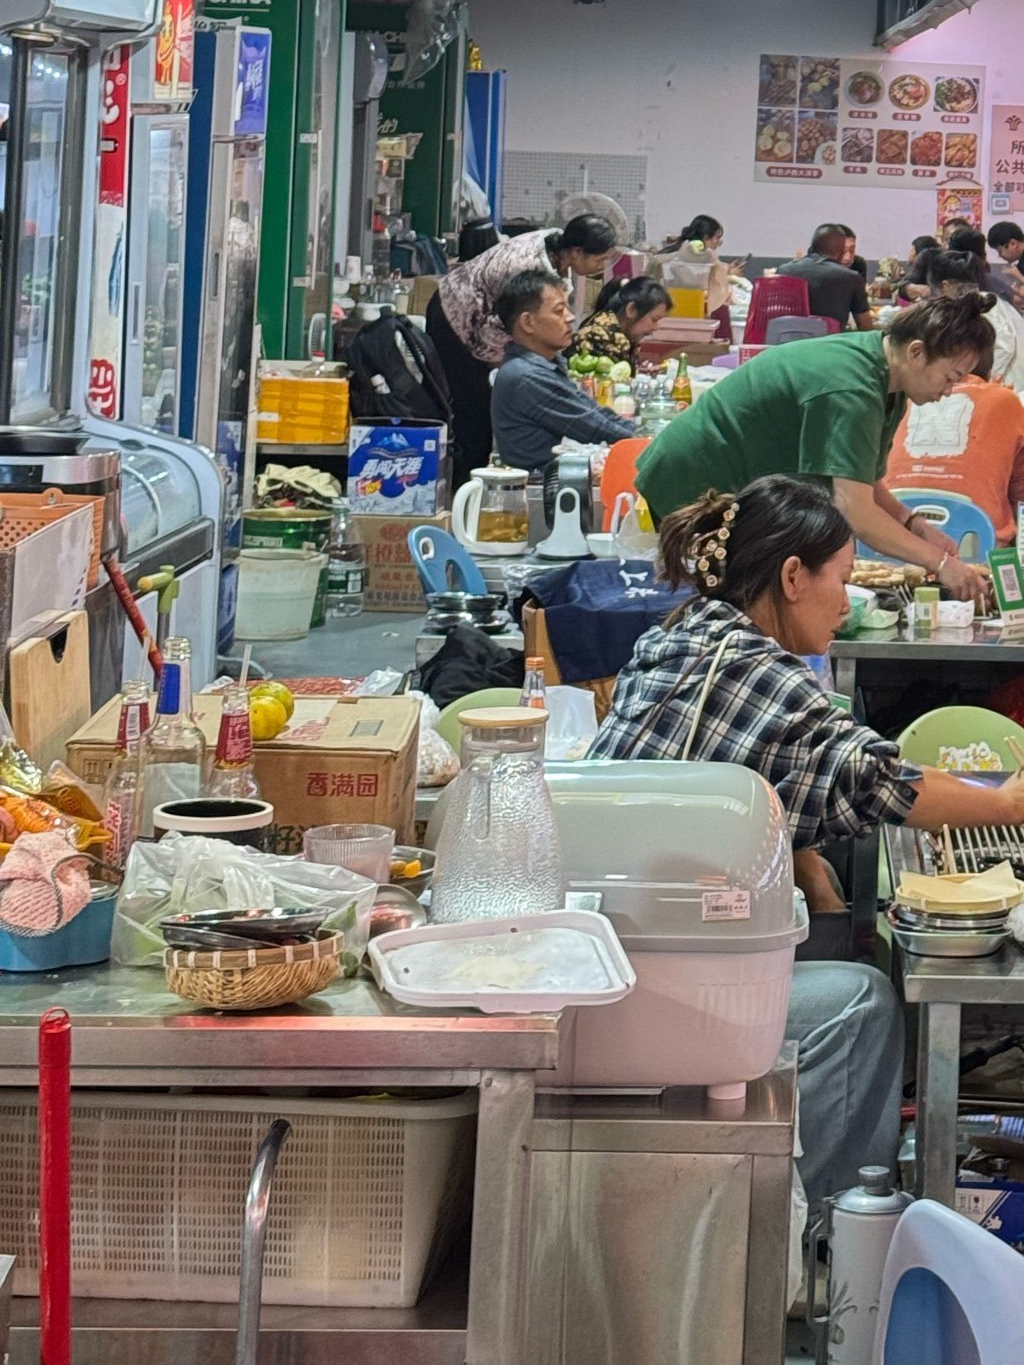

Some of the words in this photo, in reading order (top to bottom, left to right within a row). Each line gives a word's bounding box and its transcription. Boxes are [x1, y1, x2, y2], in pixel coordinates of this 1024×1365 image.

[360, 456, 424, 480] 勇闯天涯
[307, 772, 379, 798] 香满园
